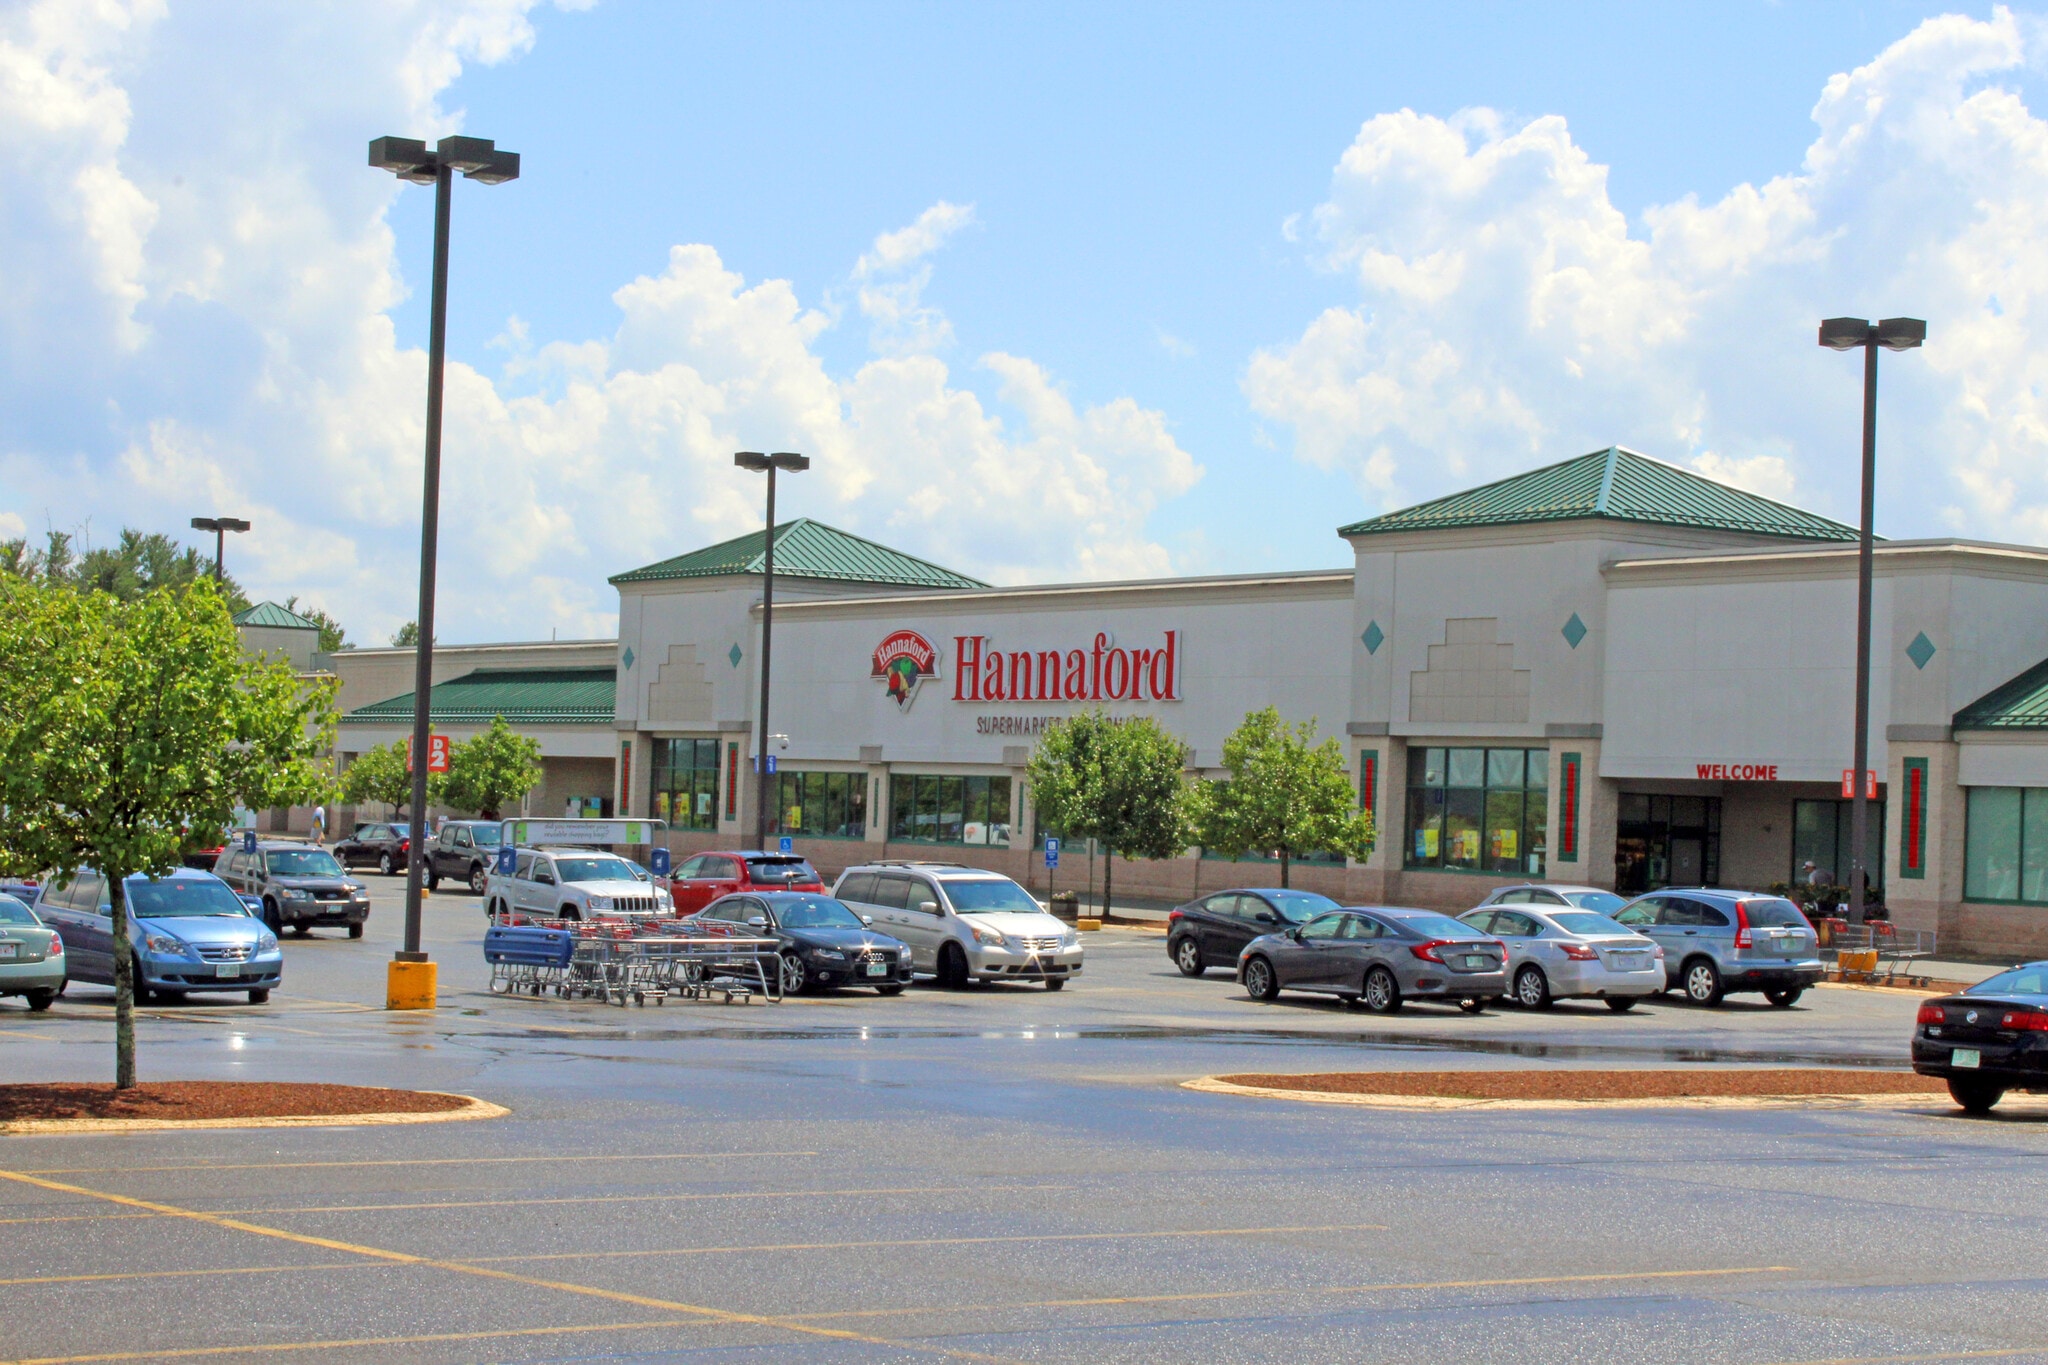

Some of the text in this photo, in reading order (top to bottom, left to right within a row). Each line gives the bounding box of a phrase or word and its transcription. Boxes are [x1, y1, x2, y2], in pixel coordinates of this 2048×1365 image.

[877, 636, 931, 666] Hannaford
[952, 630, 1178, 700] Hannaford
[433, 738, 444, 750] D
[430, 750, 446, 767] 2
[1696, 764, 1778, 780] WELCOME
